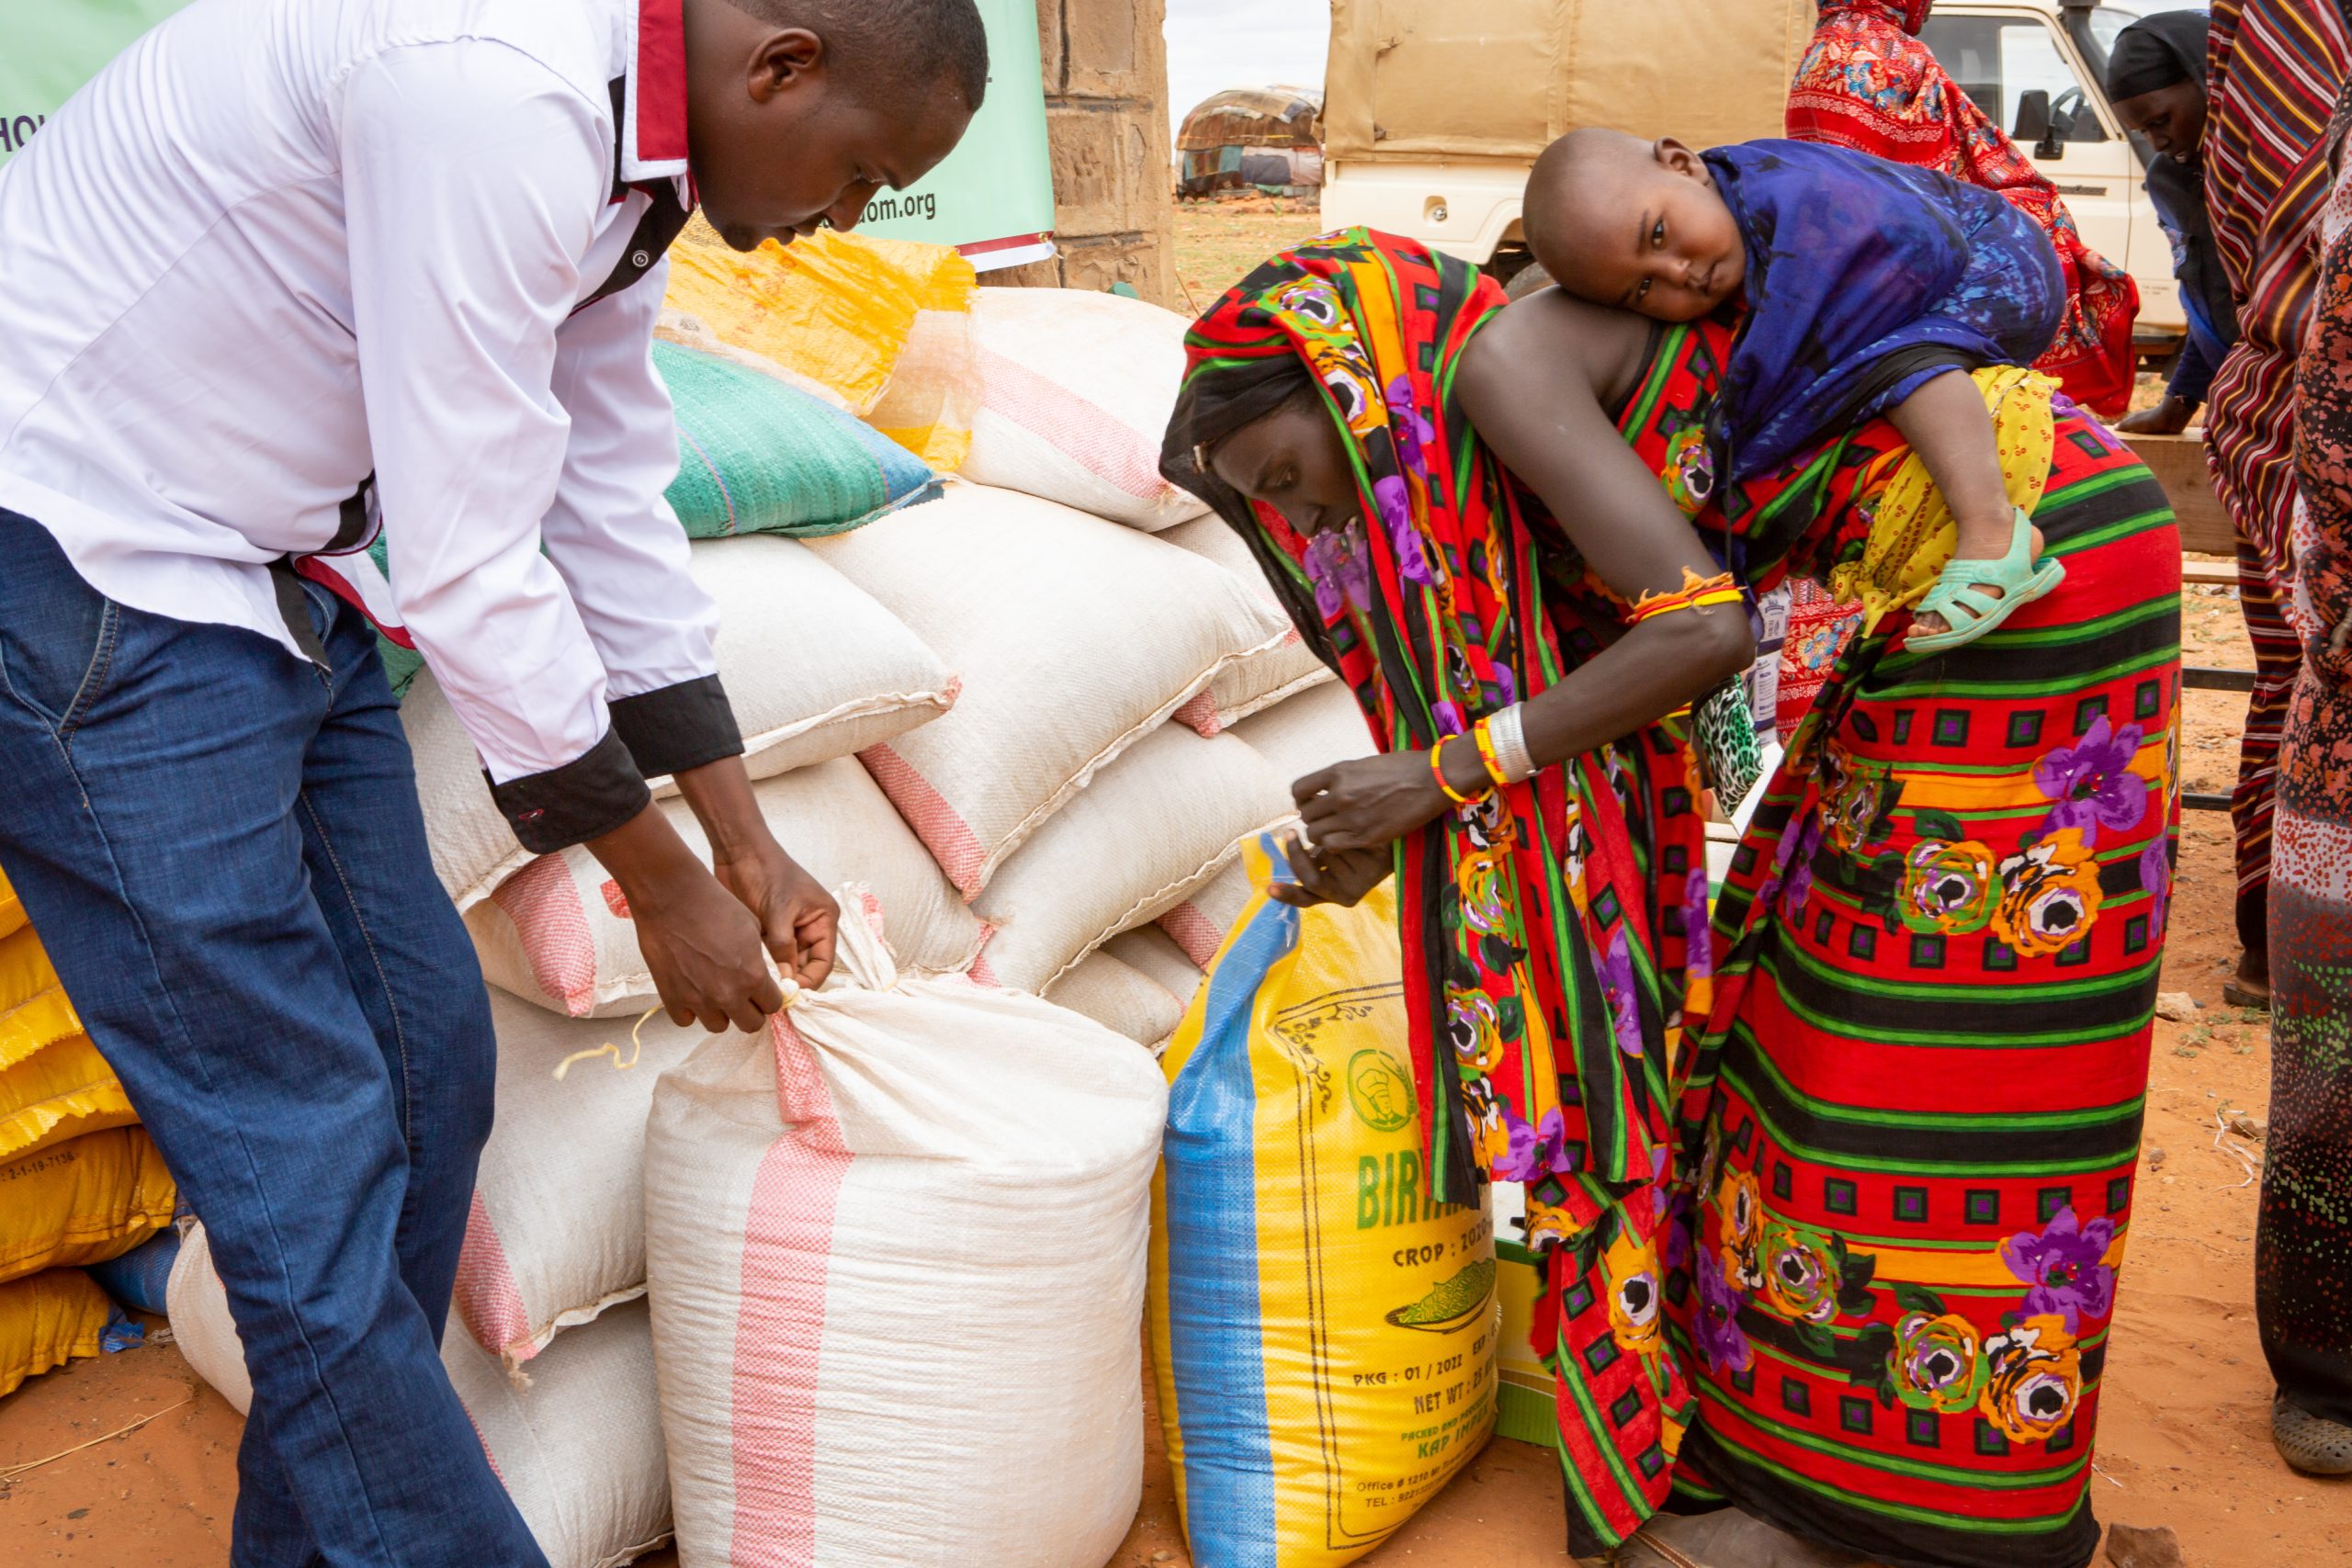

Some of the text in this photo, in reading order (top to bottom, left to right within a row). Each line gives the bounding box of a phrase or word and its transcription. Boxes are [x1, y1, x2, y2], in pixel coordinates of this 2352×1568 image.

[858, 193, 935, 223] om.org
[1393, 1243, 1444, 1267] CROP
[1353, 1371, 1386, 1386] PKG
[1405, 1366, 1420, 1381] 01
[1437, 1354, 1463, 1375] 2022
[1414, 1391, 1441, 1415] NET
[1446, 1382, 1464, 1405] WT
[1401, 1427, 1439, 1441] PACKED
[1418, 1435, 1450, 1459] KAP
[1357, 1481, 1393, 1492] Office
[1365, 1497, 1388, 1507] TEL
